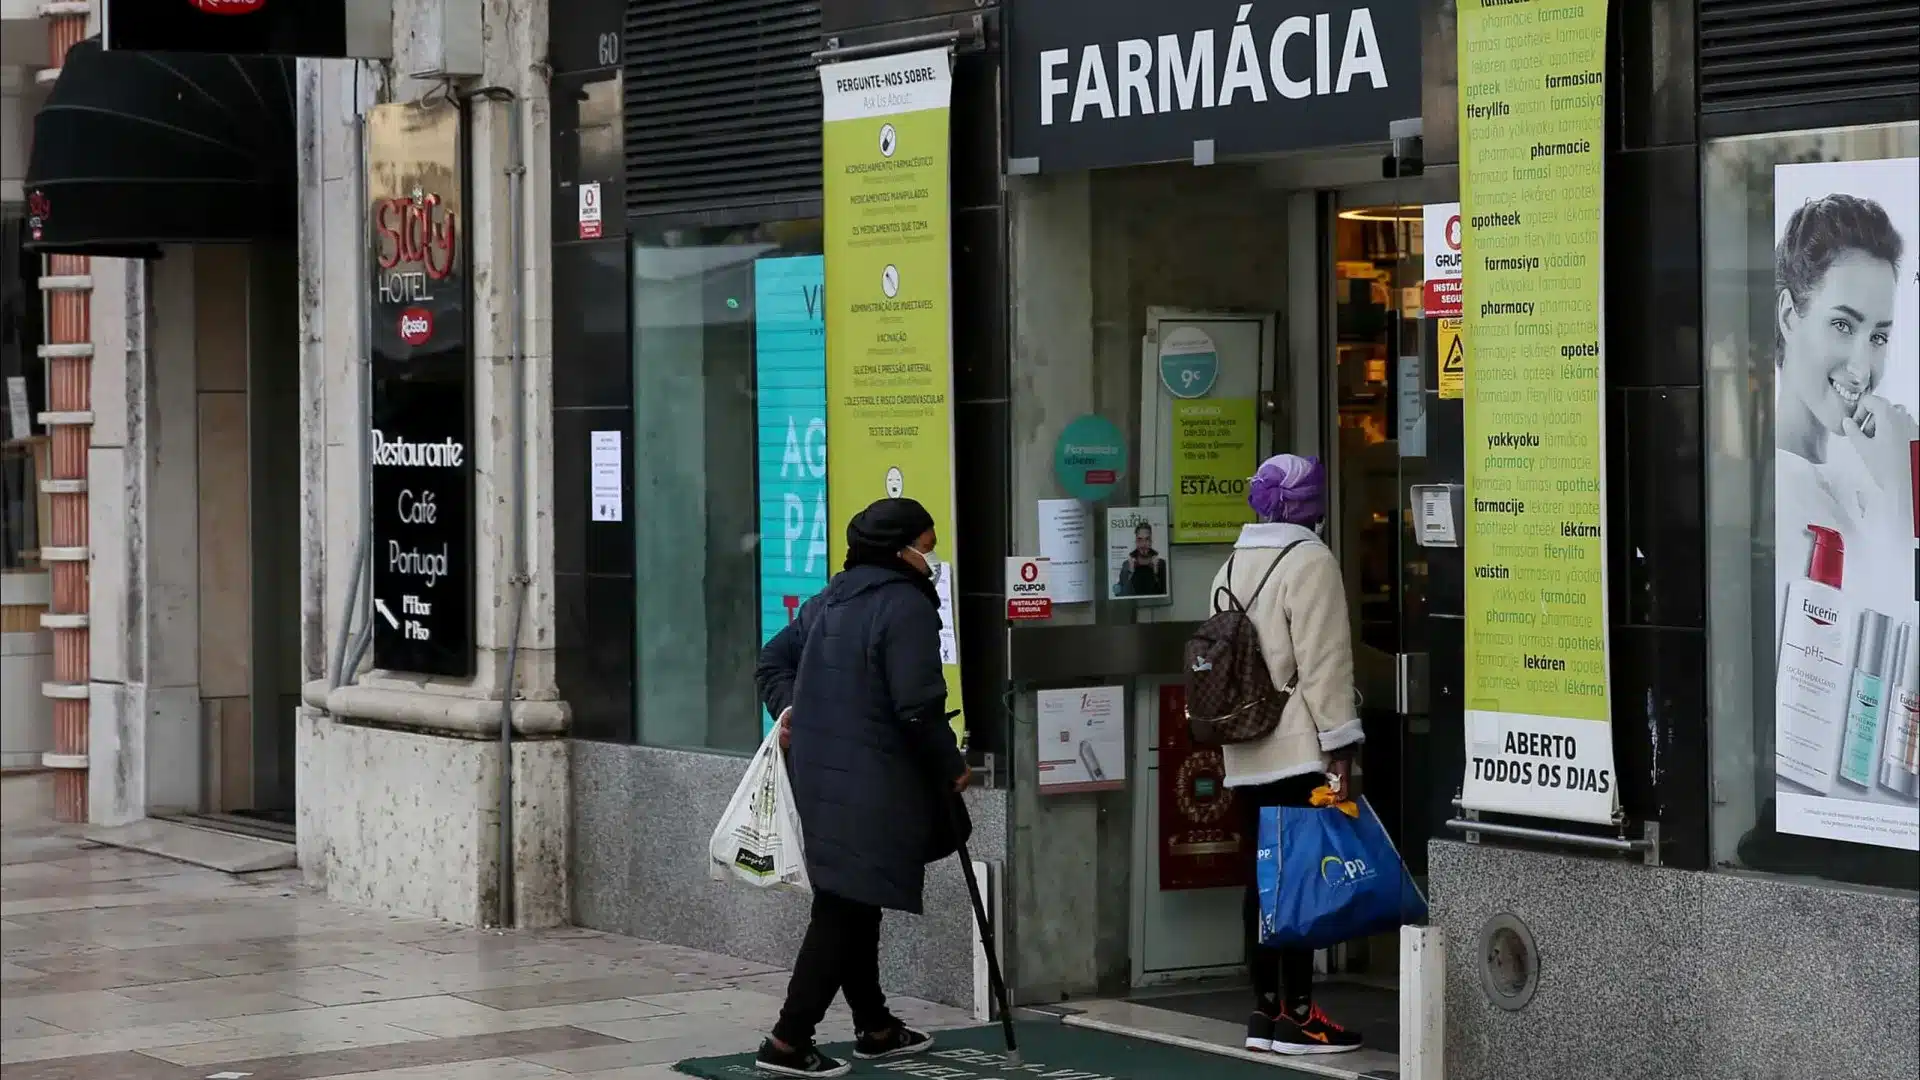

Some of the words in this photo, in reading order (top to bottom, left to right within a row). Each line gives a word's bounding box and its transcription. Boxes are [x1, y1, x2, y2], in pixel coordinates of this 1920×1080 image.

[599, 32, 618, 65] 60
[1040, 3, 1388, 125] FARMÁCIA
[837, 71, 902, 93] PERGUNTE-NOS
[905, 66, 936, 84] SOBRE:
[1545, 70, 1602, 89] farmasian
[1467, 102, 1510, 120] fferyllfa
[1531, 138, 1590, 160] pharmacie
[1472, 211, 1521, 230] apotheek
[1485, 254, 1539, 272] farmasiya
[379, 272, 434, 303] HOTEL
[1481, 301, 1535, 318] pharmacy
[402, 314, 428, 338] Rossio
[371, 429, 463, 467] Restaurante
[1488, 432, 1540, 449] yakkyoku
[398, 489, 437, 524] Café
[1474, 498, 1524, 516] farmacije
[389, 540, 448, 587] Portugal
[1474, 563, 1509, 579] vaistin
[1803, 598, 1838, 623] Eucerin
[1558, 635, 1605, 652] apothek
[1524, 653, 1565, 671] lekáren
[1505, 731, 1576, 760] ABERTO
[1473, 757, 1532, 785] TODOS
[1537, 763, 1561, 788] OS
[1566, 766, 1609, 793] DIAS
